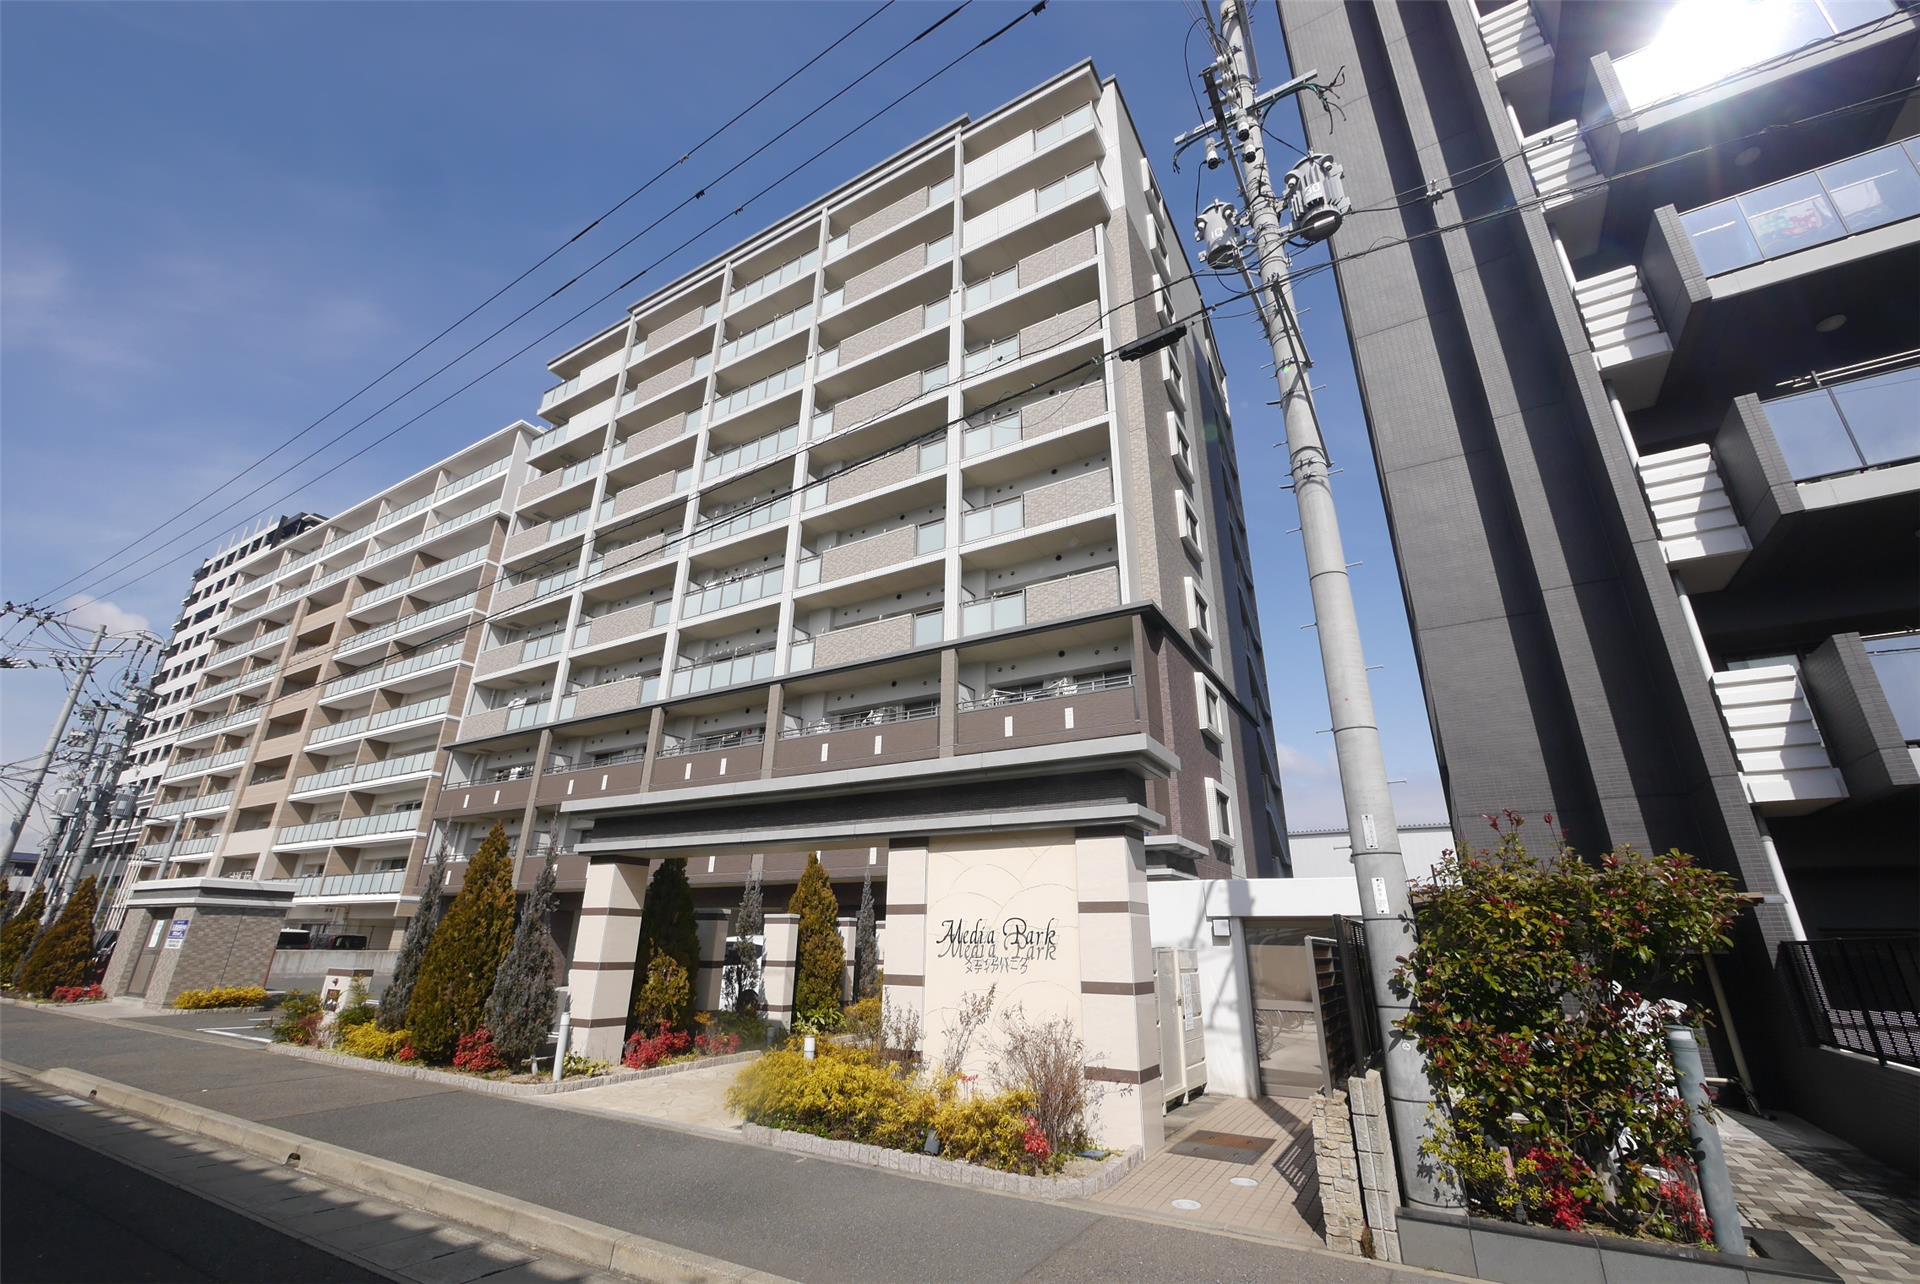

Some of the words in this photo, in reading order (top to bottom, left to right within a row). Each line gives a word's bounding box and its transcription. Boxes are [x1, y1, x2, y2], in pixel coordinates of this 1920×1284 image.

[1304, 181, 1320, 196] 30
[936, 918, 995, 944] Media
[1003, 917, 1055, 945] Park
